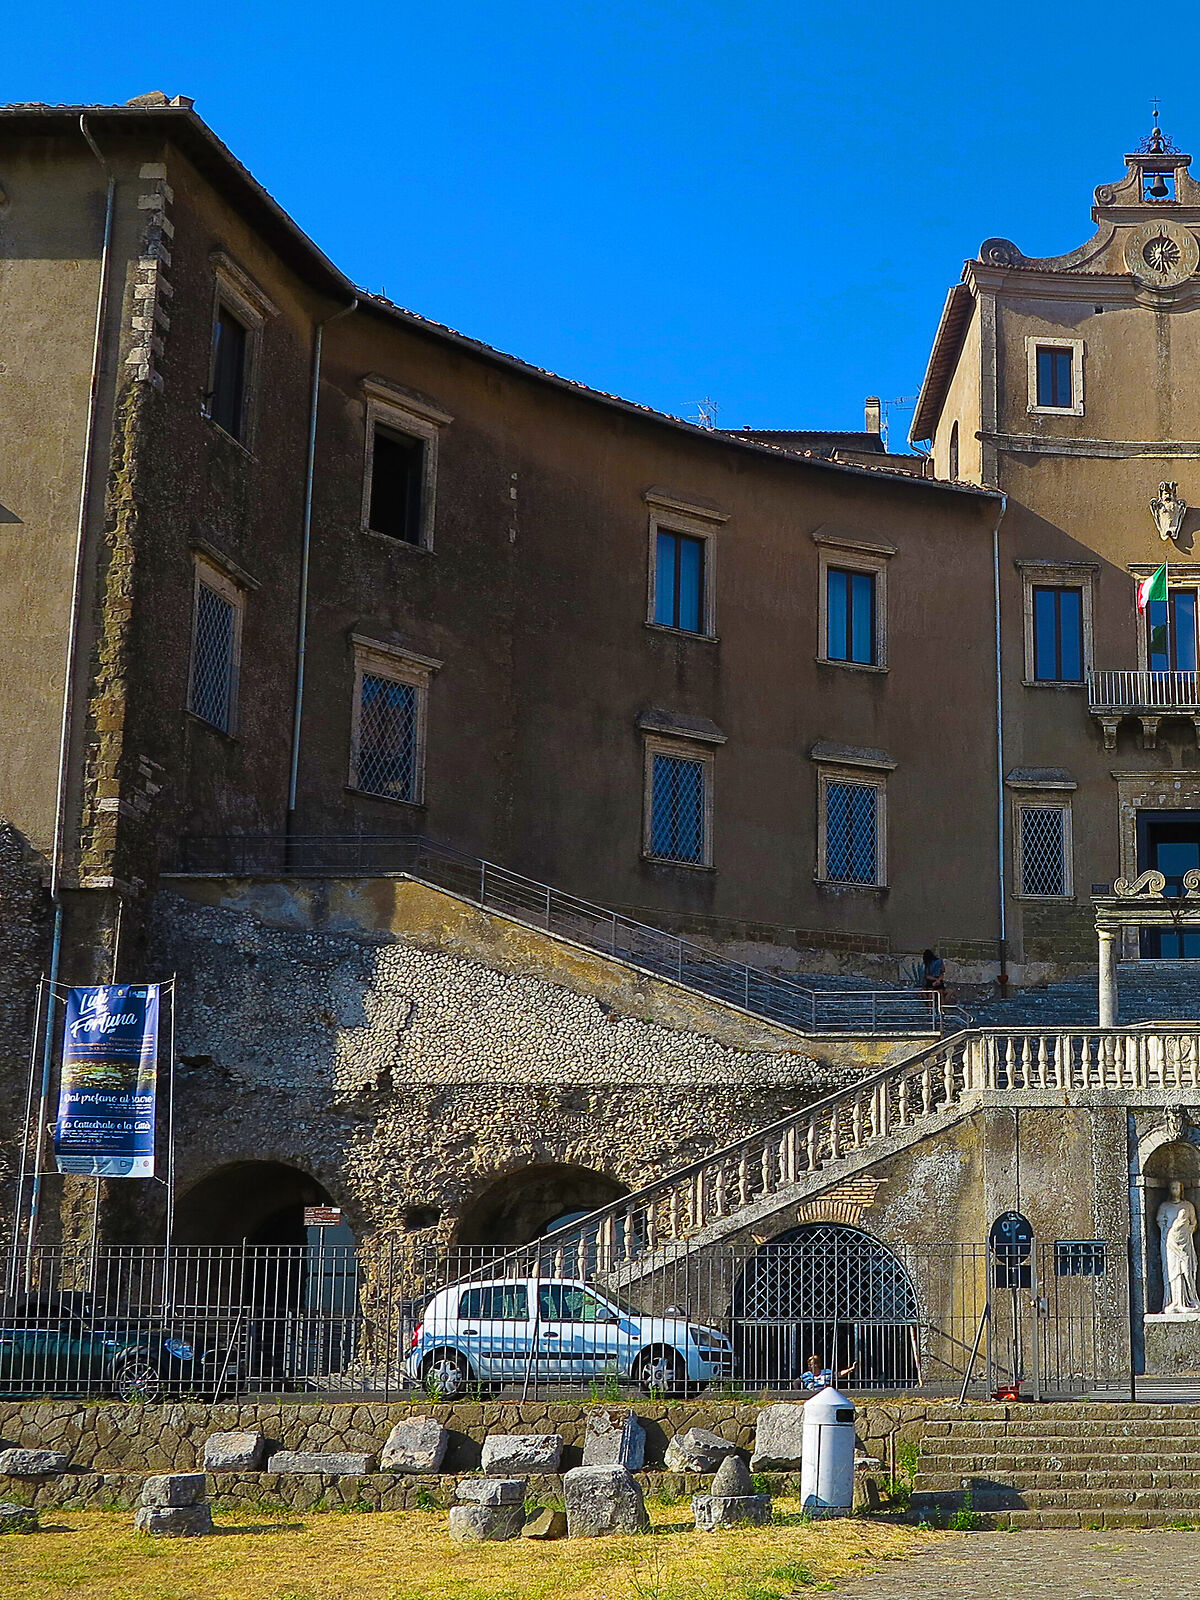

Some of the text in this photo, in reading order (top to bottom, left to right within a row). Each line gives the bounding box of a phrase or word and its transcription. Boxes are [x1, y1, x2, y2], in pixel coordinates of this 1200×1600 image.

[69, 1012, 137, 1038] Fortuna
[81, 1093, 117, 1104] profano
[131, 1095, 153, 1103] sacro
[73, 1120, 115, 1129] Cattedrale
